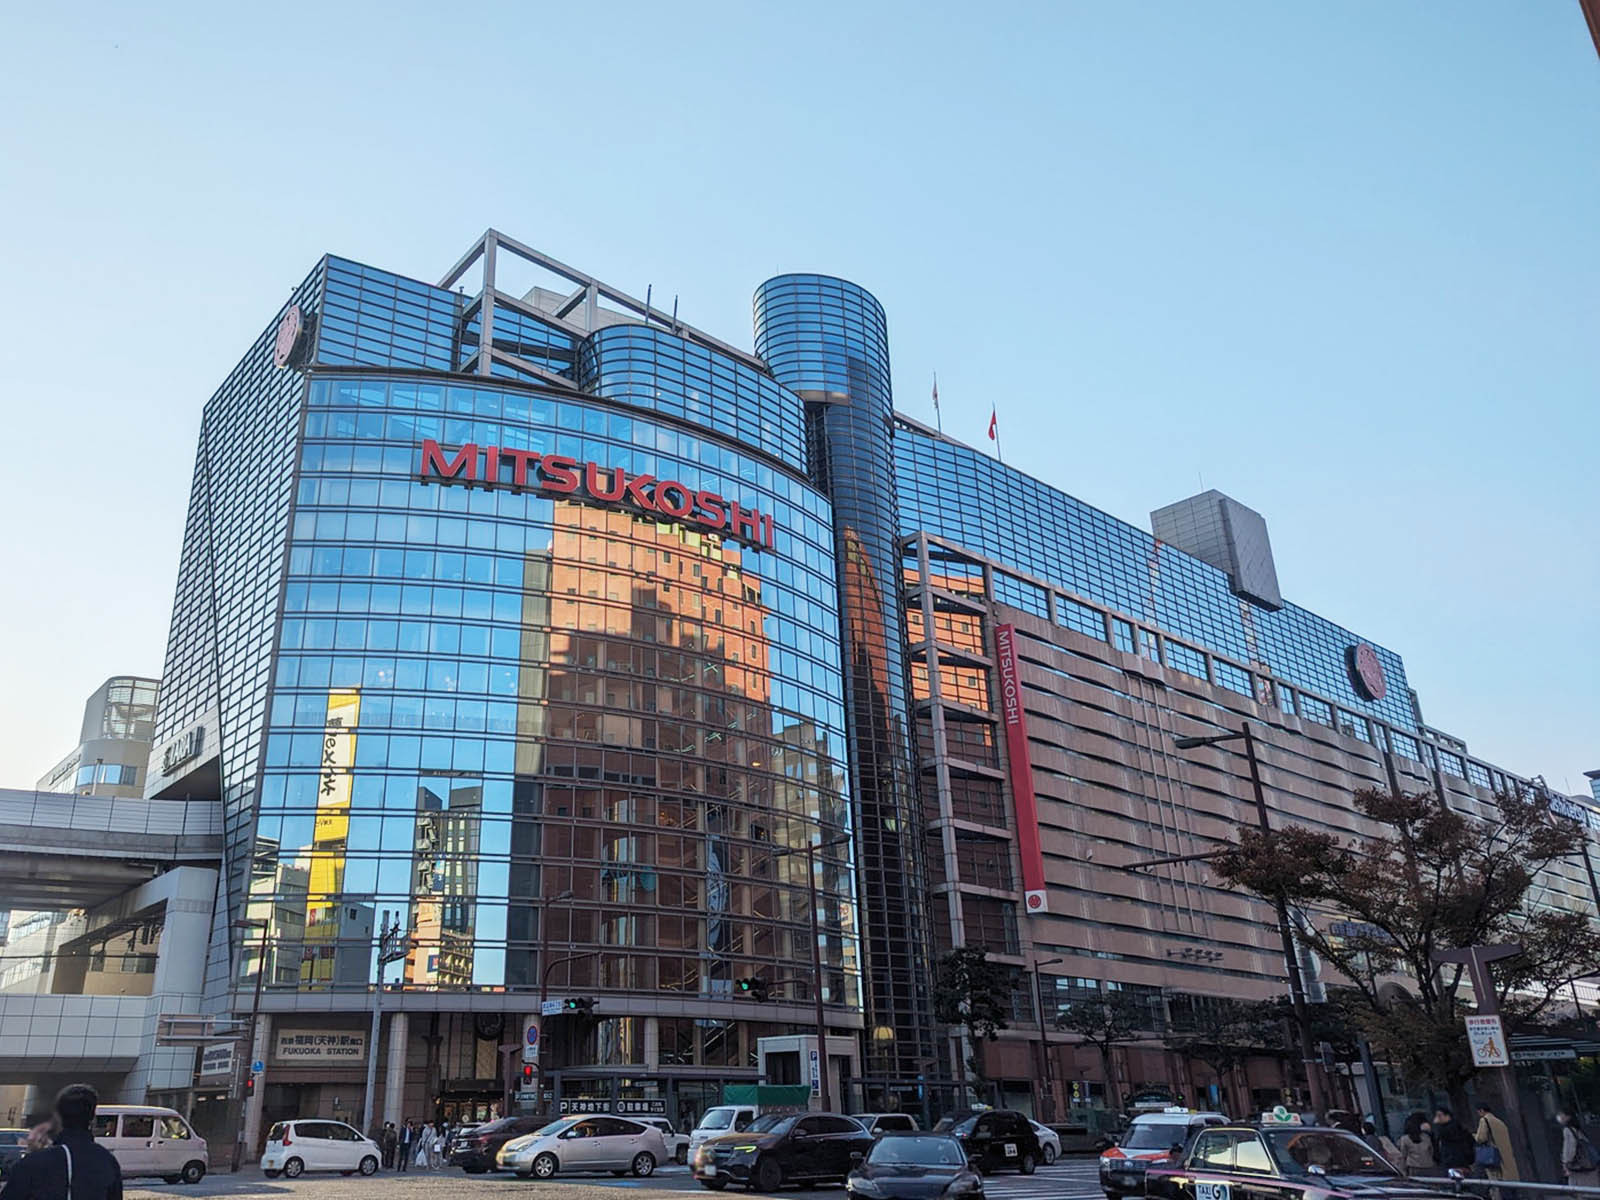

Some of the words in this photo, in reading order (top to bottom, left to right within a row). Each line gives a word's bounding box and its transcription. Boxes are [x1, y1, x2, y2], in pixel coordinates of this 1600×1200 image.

[420, 438, 774, 549] MITSUKOSHI
[999, 631, 1019, 724] MITSUKOSHI
[283, 1047, 321, 1056] FUKUOKA
[327, 1047, 359, 1056] STATION
[560, 1102, 568, 1112] P
[571, 1102, 610, 1113] 天神地下街
